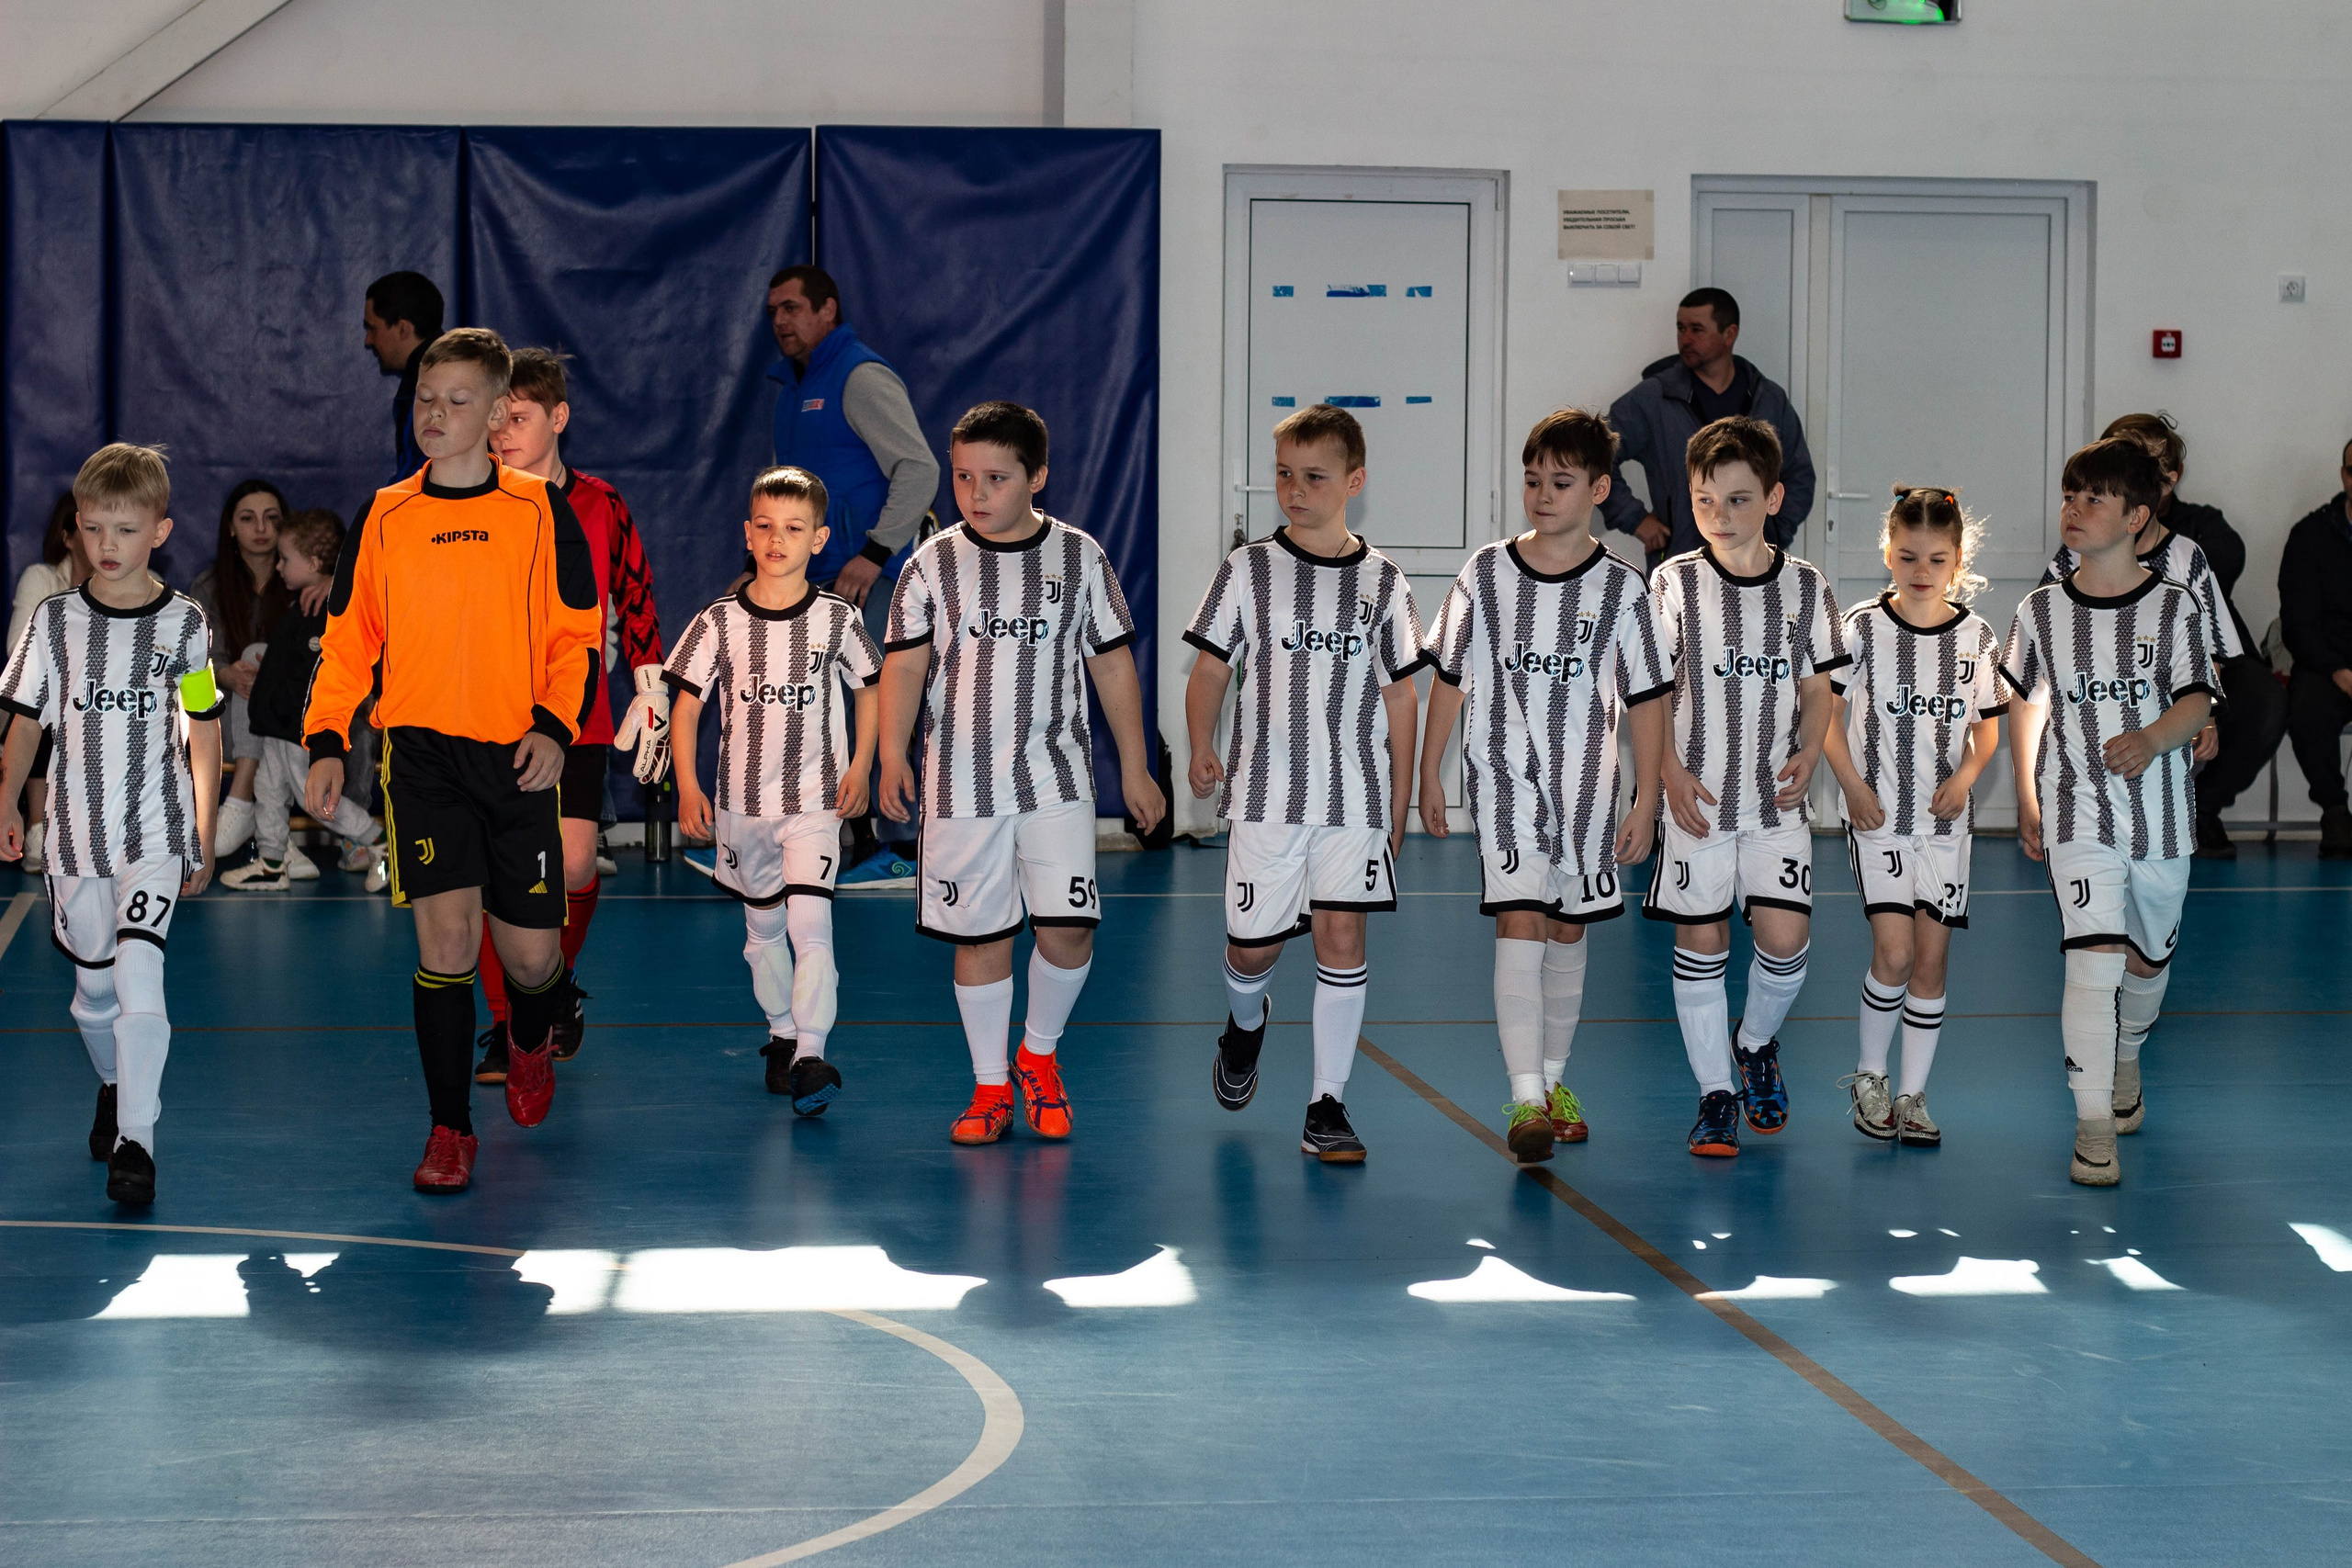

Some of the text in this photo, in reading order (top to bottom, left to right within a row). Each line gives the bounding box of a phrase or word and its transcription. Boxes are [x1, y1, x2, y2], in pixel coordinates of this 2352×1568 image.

[967, 609, 1050, 645] Jeep
[1281, 620, 1363, 662] Jeep
[1504, 642, 1584, 683] Jeep
[1713, 646, 1791, 686] Jeep
[73, 679, 157, 720] Jeep
[741, 673, 816, 712] Jeep
[1885, 684, 1967, 724] Jeep
[2067, 671, 2152, 708] Jeep
[640, 739, 651, 772] ALPHA
[537, 851, 546, 878] 1
[820, 855, 832, 880] 7
[1365, 860, 1379, 891] 5
[1779, 857, 1811, 896] 30
[1069, 876, 1096, 909] 59
[1581, 873, 1615, 903] 10
[126, 890, 171, 928] 87
